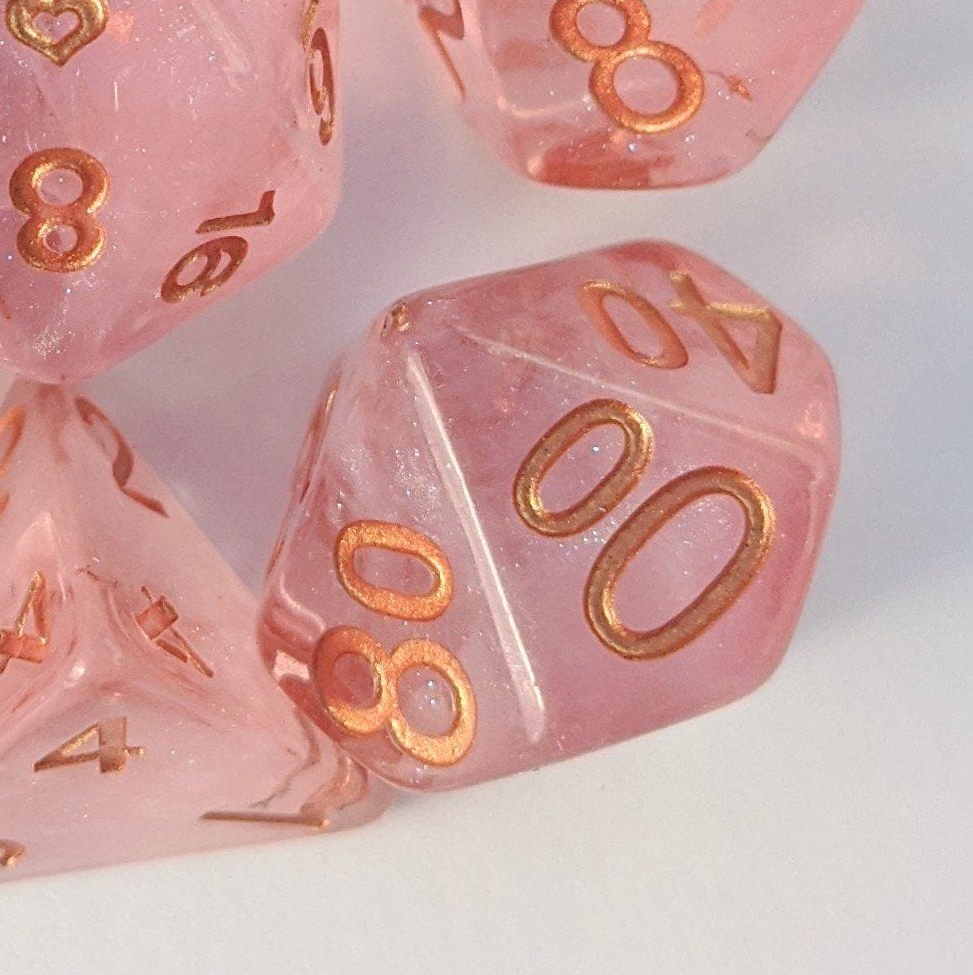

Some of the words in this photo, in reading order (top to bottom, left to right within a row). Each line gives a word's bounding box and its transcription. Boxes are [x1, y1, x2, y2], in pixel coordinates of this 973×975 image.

[9, 147, 111, 274] 8
[159, 189, 277, 305] 16
[580, 272, 782, 394] 40
[512, 398, 777, 661] 00
[311, 519, 477, 767] 80
[33, 719, 145, 774] 4
